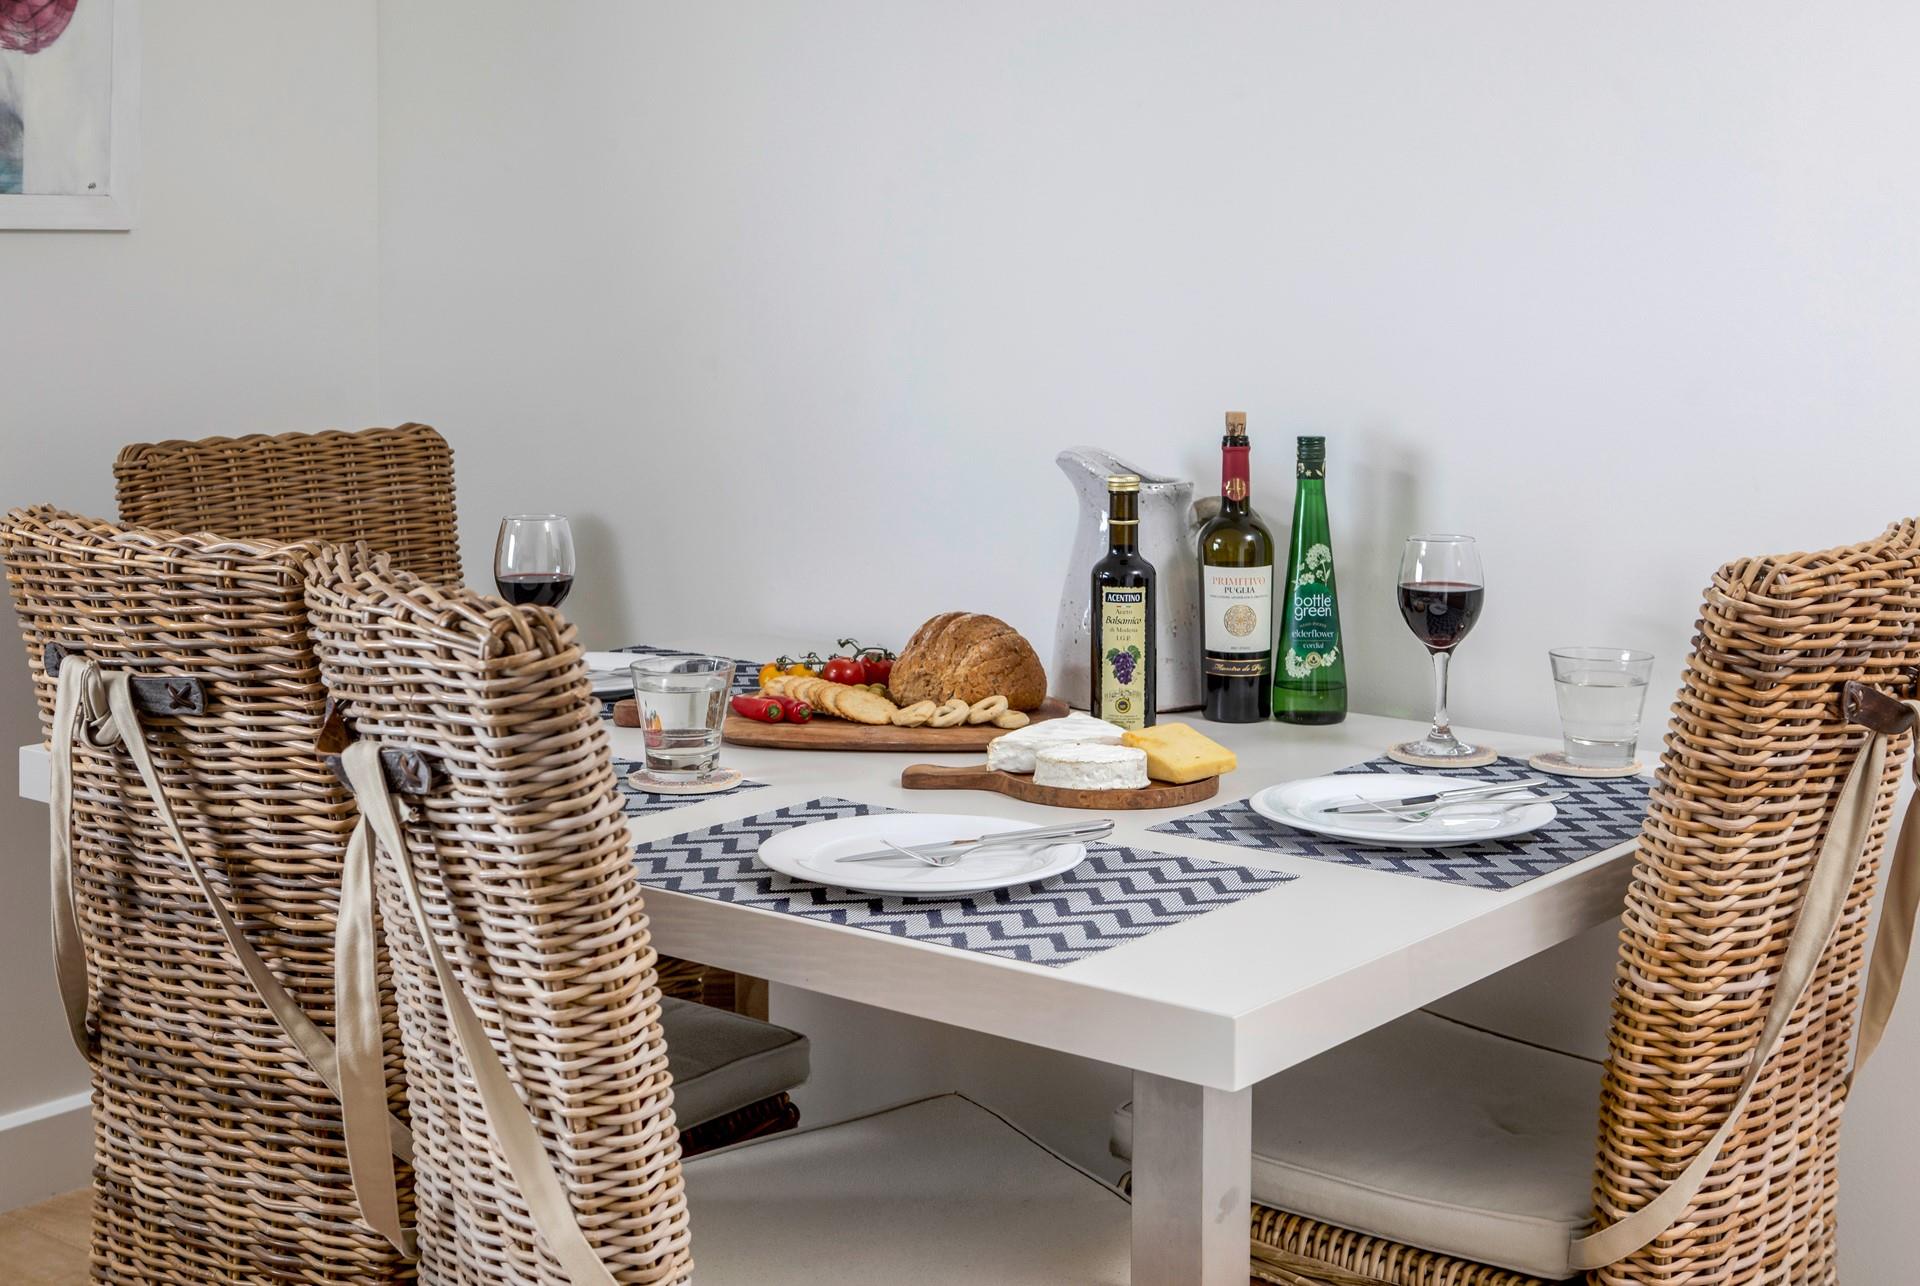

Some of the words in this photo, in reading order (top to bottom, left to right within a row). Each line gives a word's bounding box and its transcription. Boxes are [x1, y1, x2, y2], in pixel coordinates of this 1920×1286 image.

[1212, 576, 1266, 586] PRIMITIVO
[1224, 586, 1255, 594] PUGLIA
[1107, 594, 1140, 602] ACENTINO
[1294, 593, 1332, 607] bottle
[1294, 606, 1332, 621] green
[1106, 616, 1142, 625] Balsamico
[1291, 629, 1334, 638] elderflower
